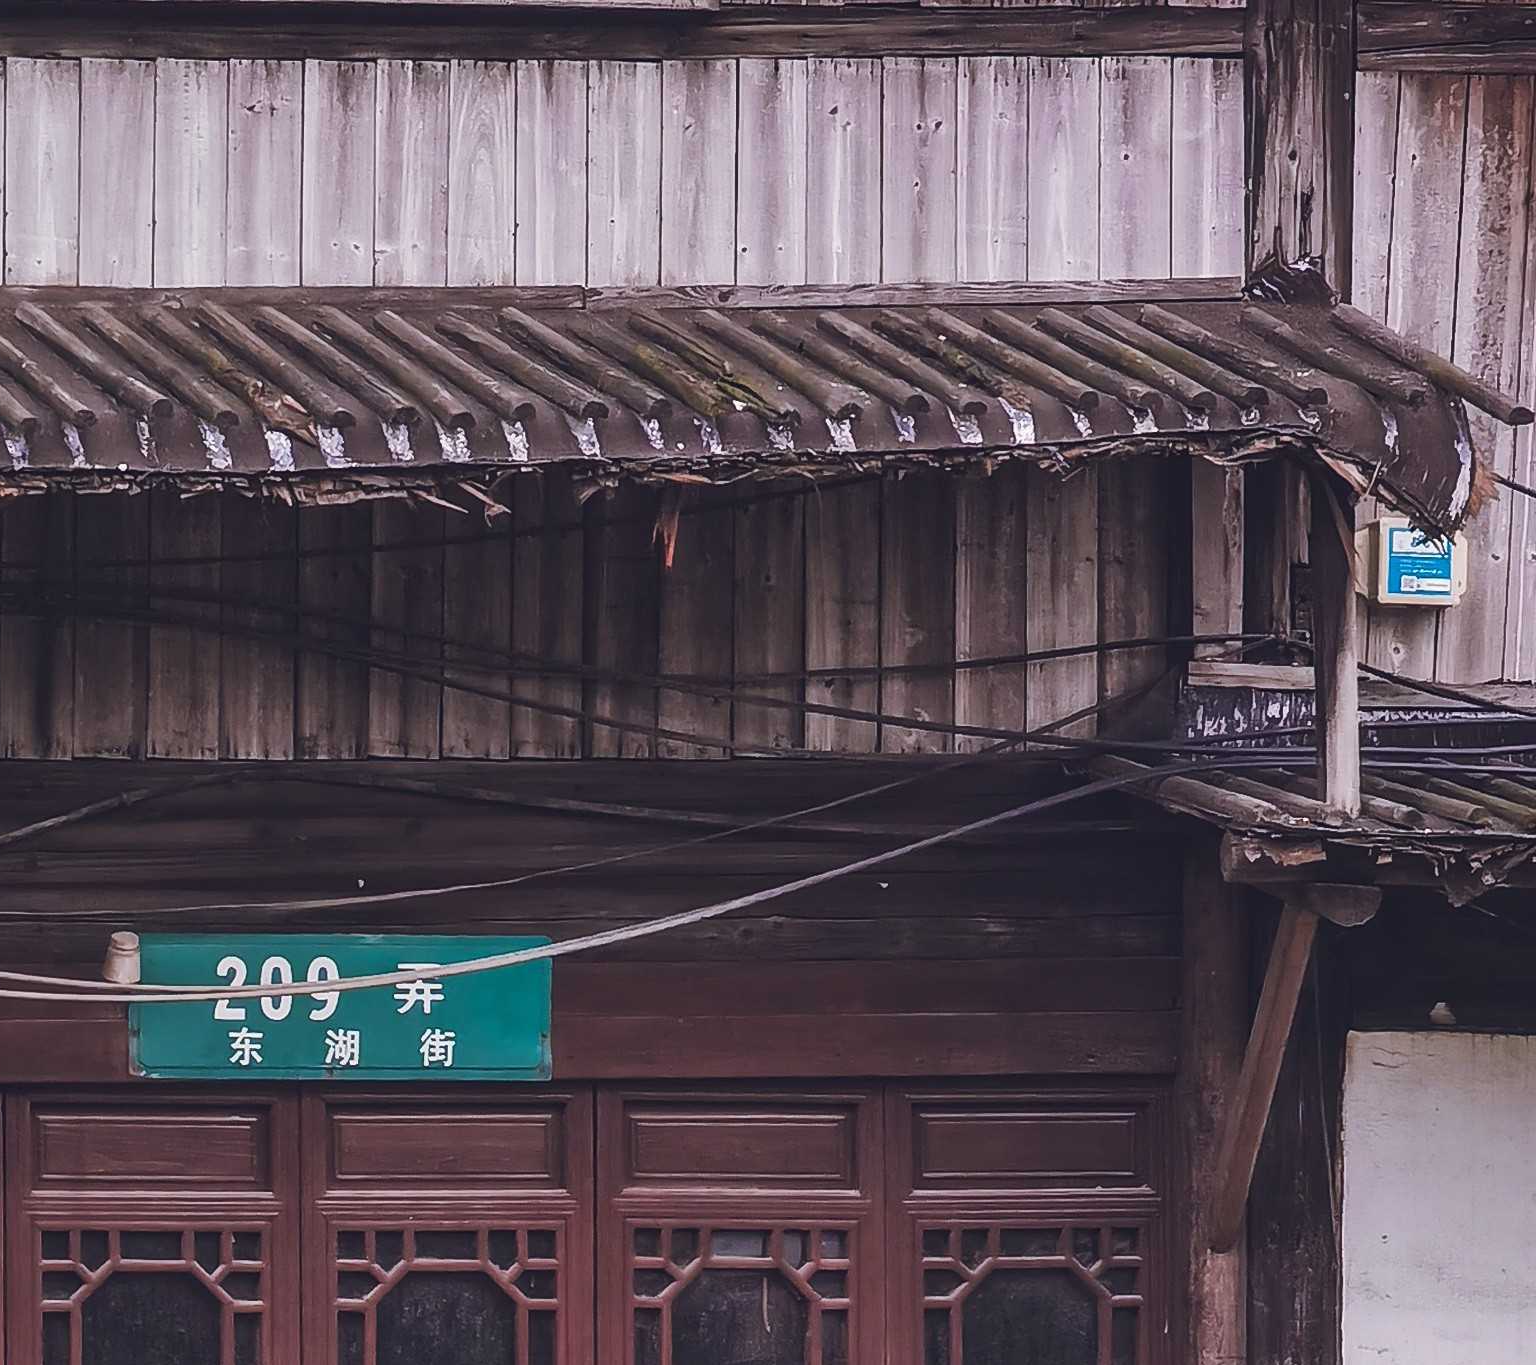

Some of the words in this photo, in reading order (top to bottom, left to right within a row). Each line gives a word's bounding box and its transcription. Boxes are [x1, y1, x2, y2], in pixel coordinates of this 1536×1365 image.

[214, 956, 341, 1021] 209
[228, 1027, 456, 1067] 东湖街
